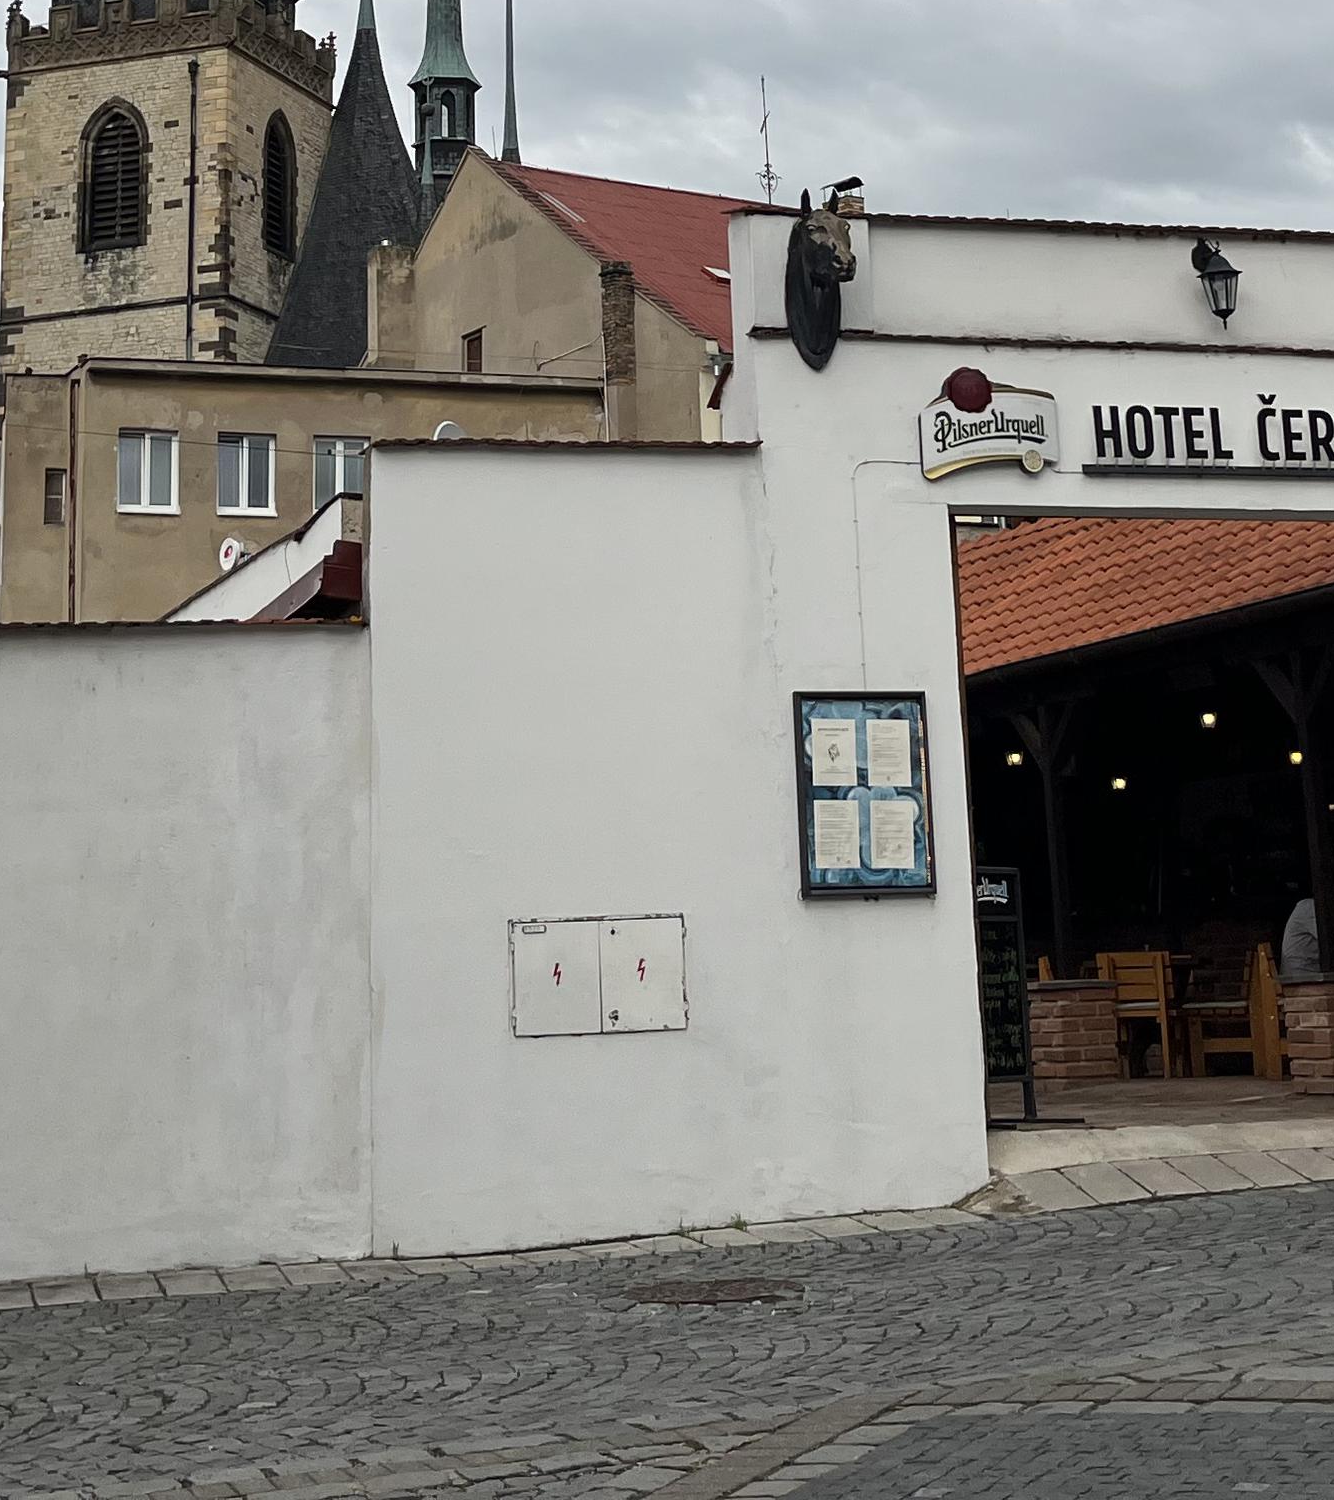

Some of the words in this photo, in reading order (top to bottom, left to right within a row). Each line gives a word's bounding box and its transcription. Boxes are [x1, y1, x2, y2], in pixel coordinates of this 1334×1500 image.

[933, 410, 994, 453] Pilsner
[990, 408, 1046, 444] Urquell
[1092, 404, 1234, 460] HOTEL
